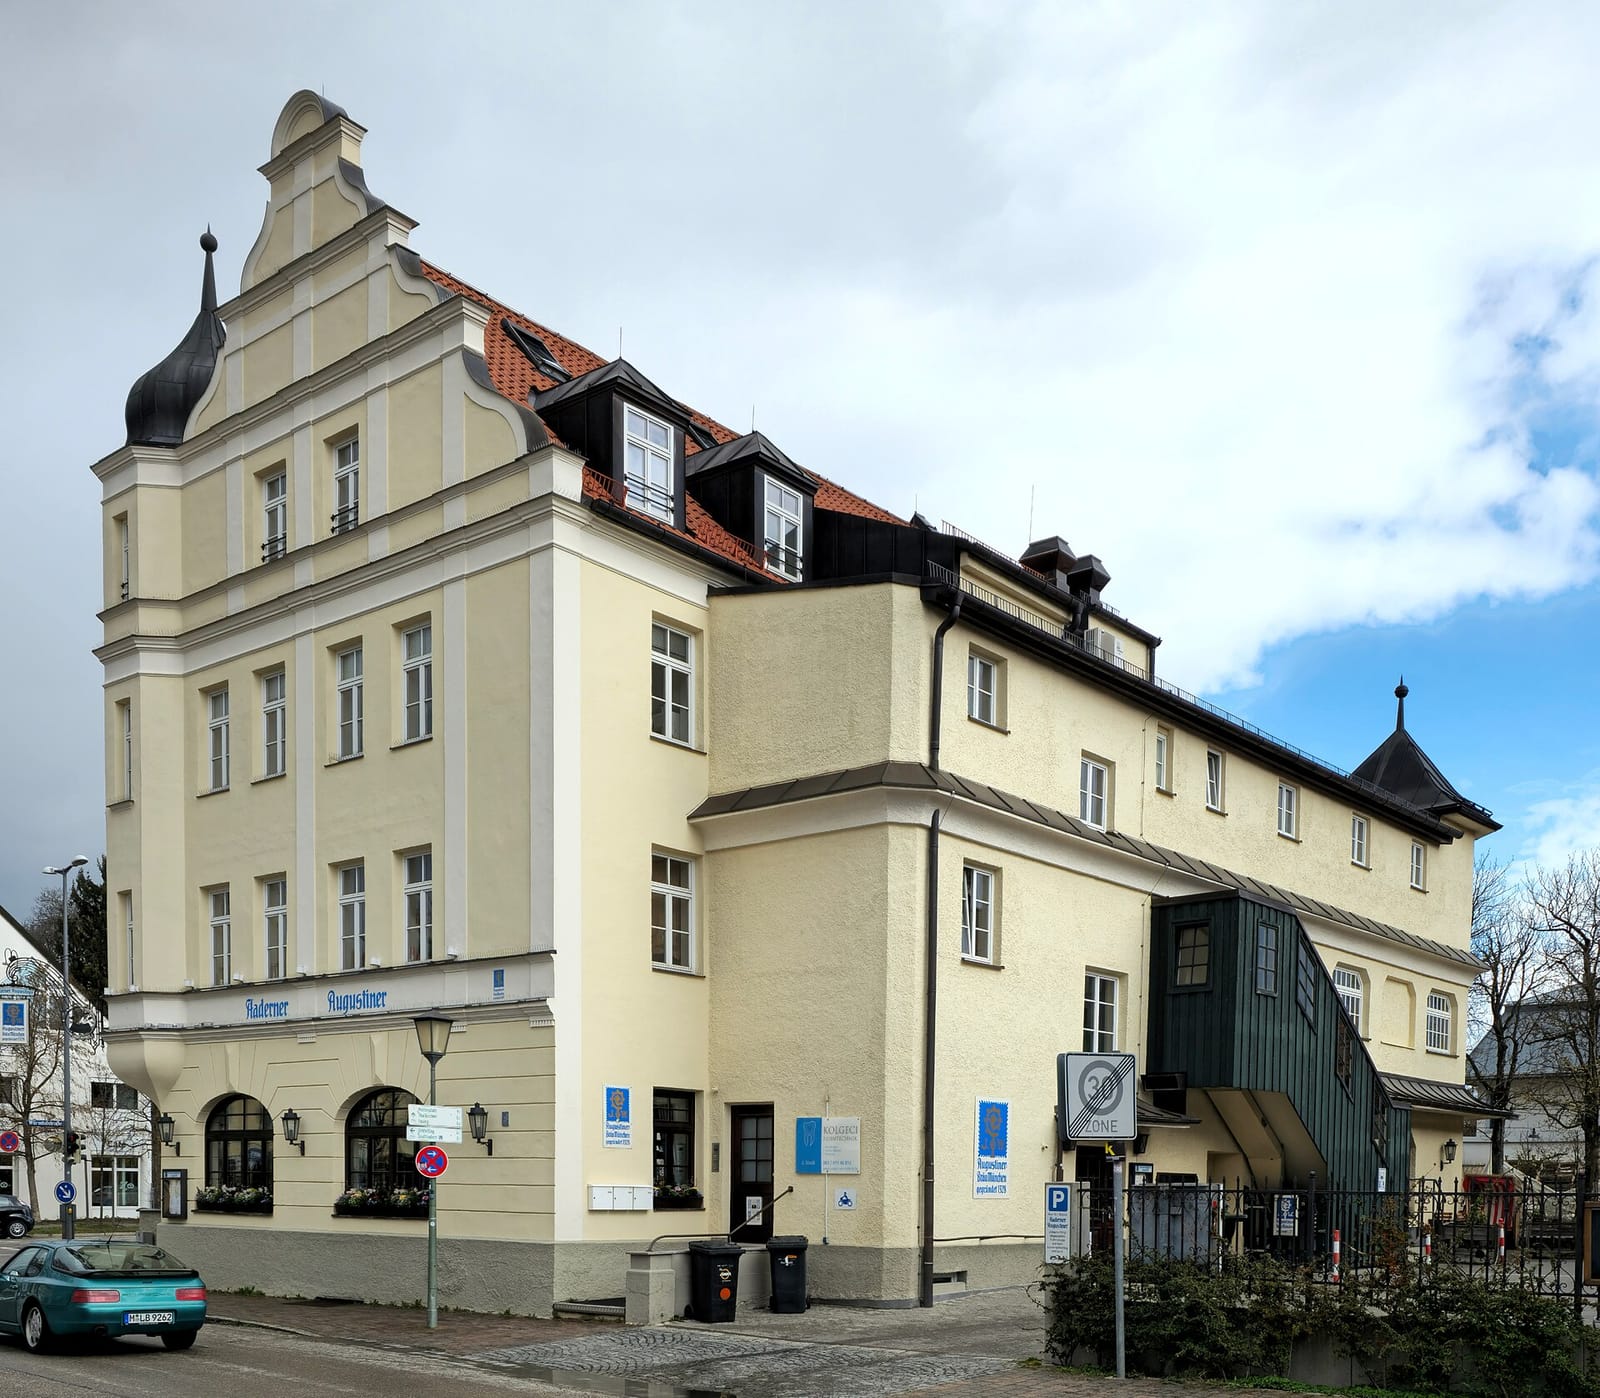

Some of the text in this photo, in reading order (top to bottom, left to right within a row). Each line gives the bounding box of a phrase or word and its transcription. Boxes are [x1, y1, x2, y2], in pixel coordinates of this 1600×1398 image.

[246, 990, 387, 1019] Haderner Augustiner
[1087, 1075, 1114, 1101] 30
[823, 1125, 858, 1135] KOLGECI
[1085, 1119, 1119, 1133] ZONE
[977, 1158, 1007, 1171] Augustiner
[152, 1313, 172, 1322] 9262
